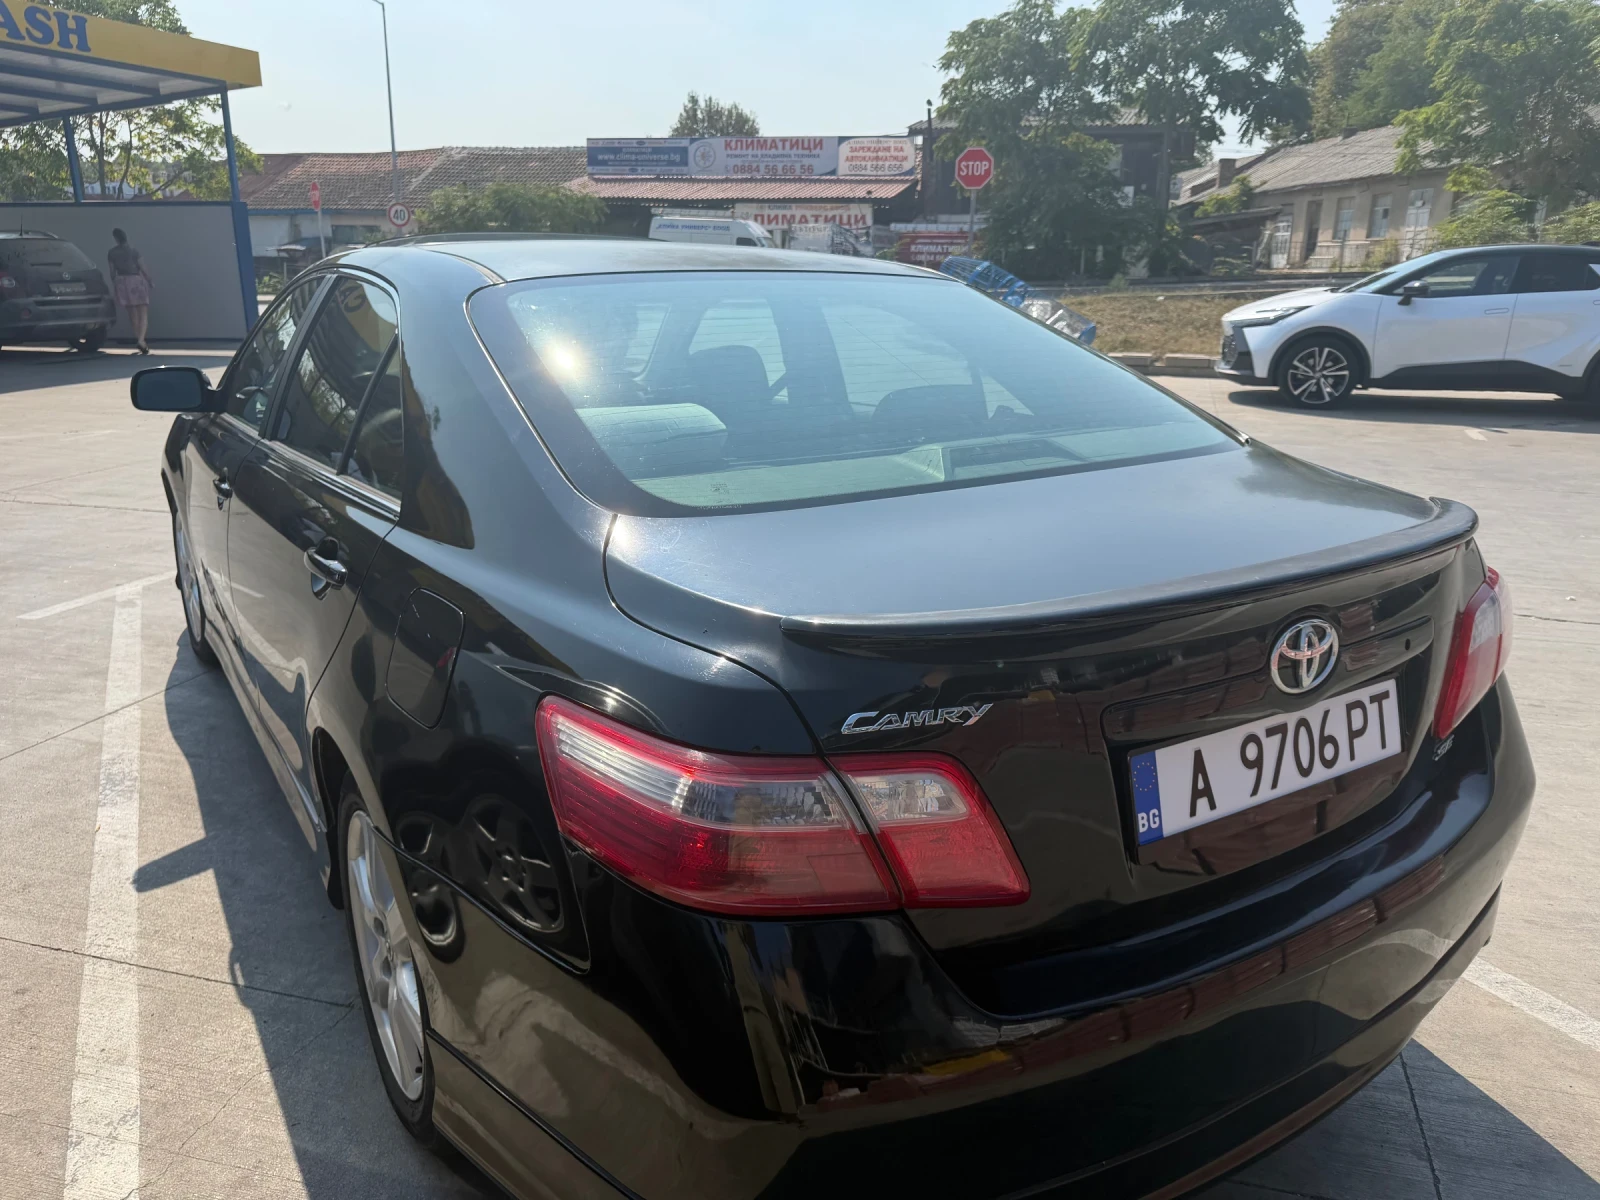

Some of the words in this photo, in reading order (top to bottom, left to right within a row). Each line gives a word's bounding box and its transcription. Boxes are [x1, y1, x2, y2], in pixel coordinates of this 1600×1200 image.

[724, 138, 824, 152] КЛИМАТИЦИ
[849, 145, 891, 154] ЗАРЕЖДАНЕ
[597, 152, 681, 162] www.clima-universe.bg
[733, 164, 760, 175] 0884
[764, 164, 779, 175] 56
[782, 164, 796, 175] 66
[800, 164, 815, 175] 56
[848, 163, 868, 172] 0884
[887, 163, 904, 172] 656
[959, 161, 990, 176] STOP
[393, 208, 406, 221] 40
[841, 703, 994, 735] CAMRY
[1189, 748, 1217, 818] A
[1138, 808, 1160, 834] BG
